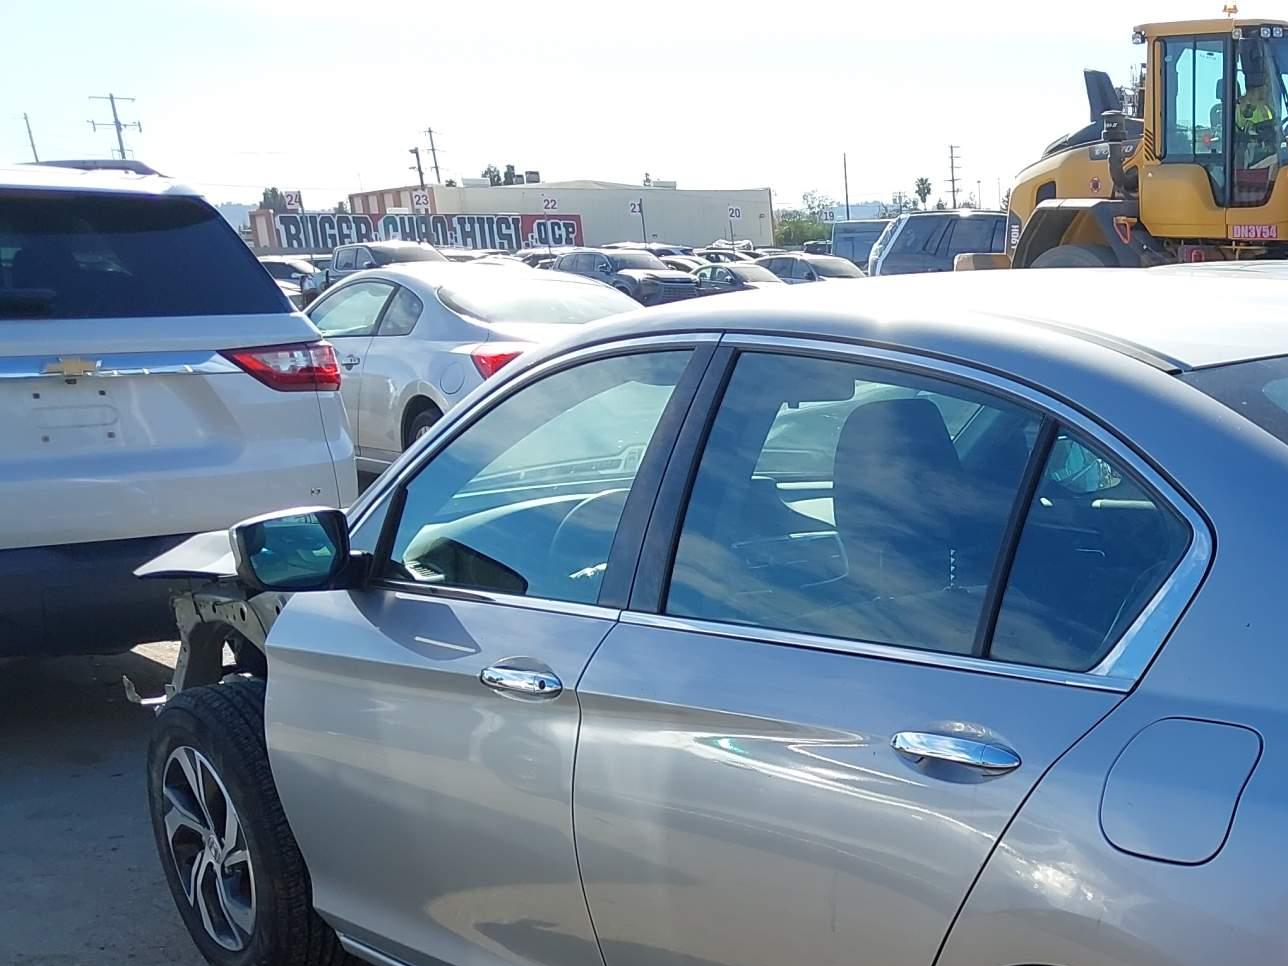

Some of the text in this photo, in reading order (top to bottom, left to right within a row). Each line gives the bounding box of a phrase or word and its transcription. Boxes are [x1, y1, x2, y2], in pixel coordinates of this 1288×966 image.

[414, 194, 430, 206] 23
[543, 199, 558, 210] 22
[728, 208, 742, 218] 20
[823, 211, 835, 221] 19
